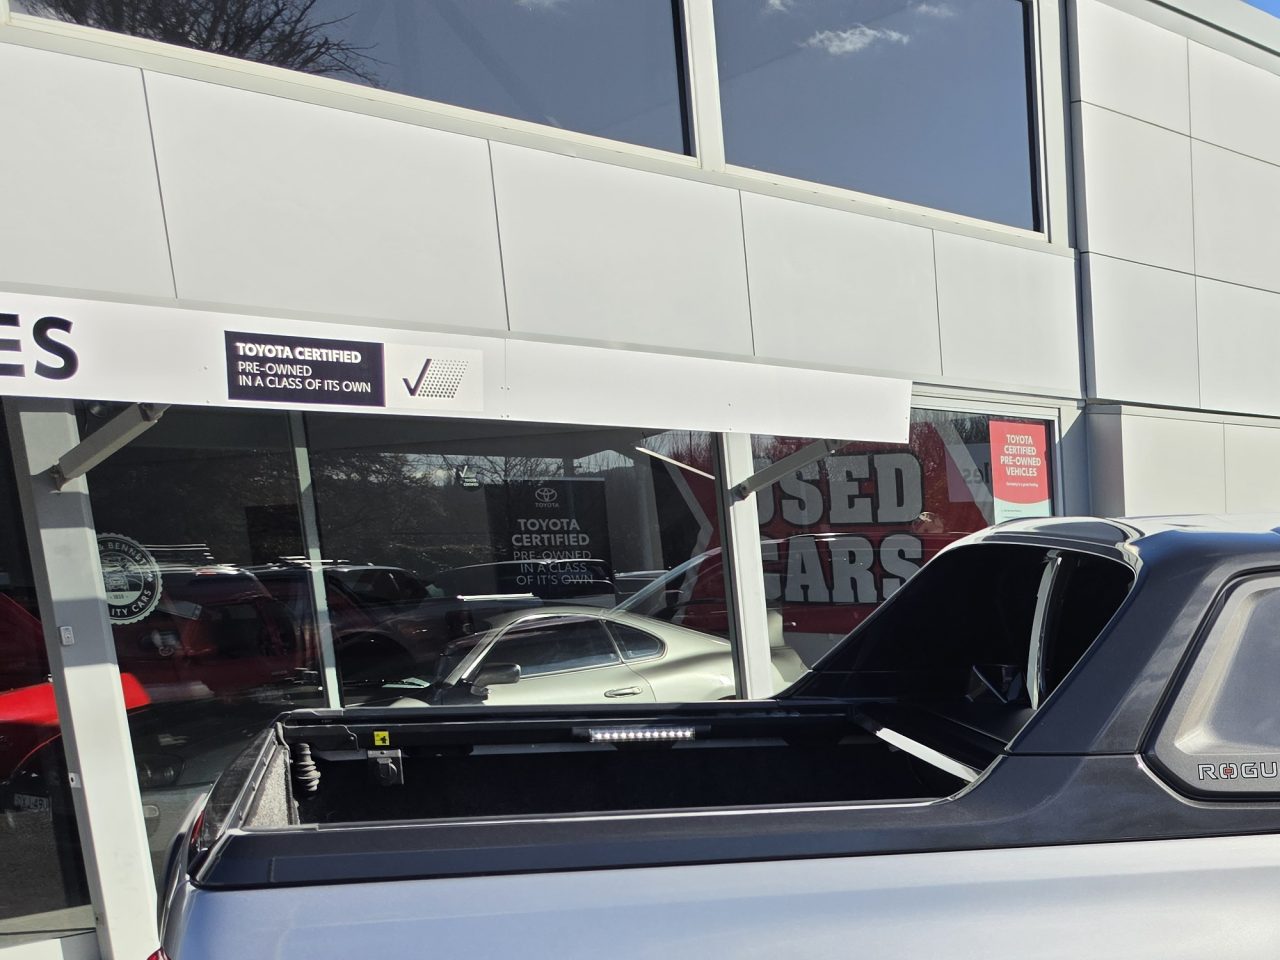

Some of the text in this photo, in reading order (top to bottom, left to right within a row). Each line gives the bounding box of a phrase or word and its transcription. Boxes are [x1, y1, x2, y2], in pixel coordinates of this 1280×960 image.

[235, 342, 361, 363] TOYOTA CERTIFIED
[238, 361, 312, 376] PRE-OWNED
[239, 375, 371, 393] IN A CLASS OF ITS OWN
[1006, 434, 1033, 444] TOYOTA
[1004, 445, 1037, 455] CERTIFIED
[1000, 456, 1041, 466] PRE-OWNED
[1006, 466, 1038, 476] VEHICLES
[517, 518, 581, 531] TOYOTA
[511, 534, 590, 546] CERTIFIED
[513, 550, 592, 561] PRE-OWNED
[520, 562, 587, 573] IN A CLASS
[516, 574, 593, 585] OF IT'S OWN
[132, 589, 152, 612] CARS
